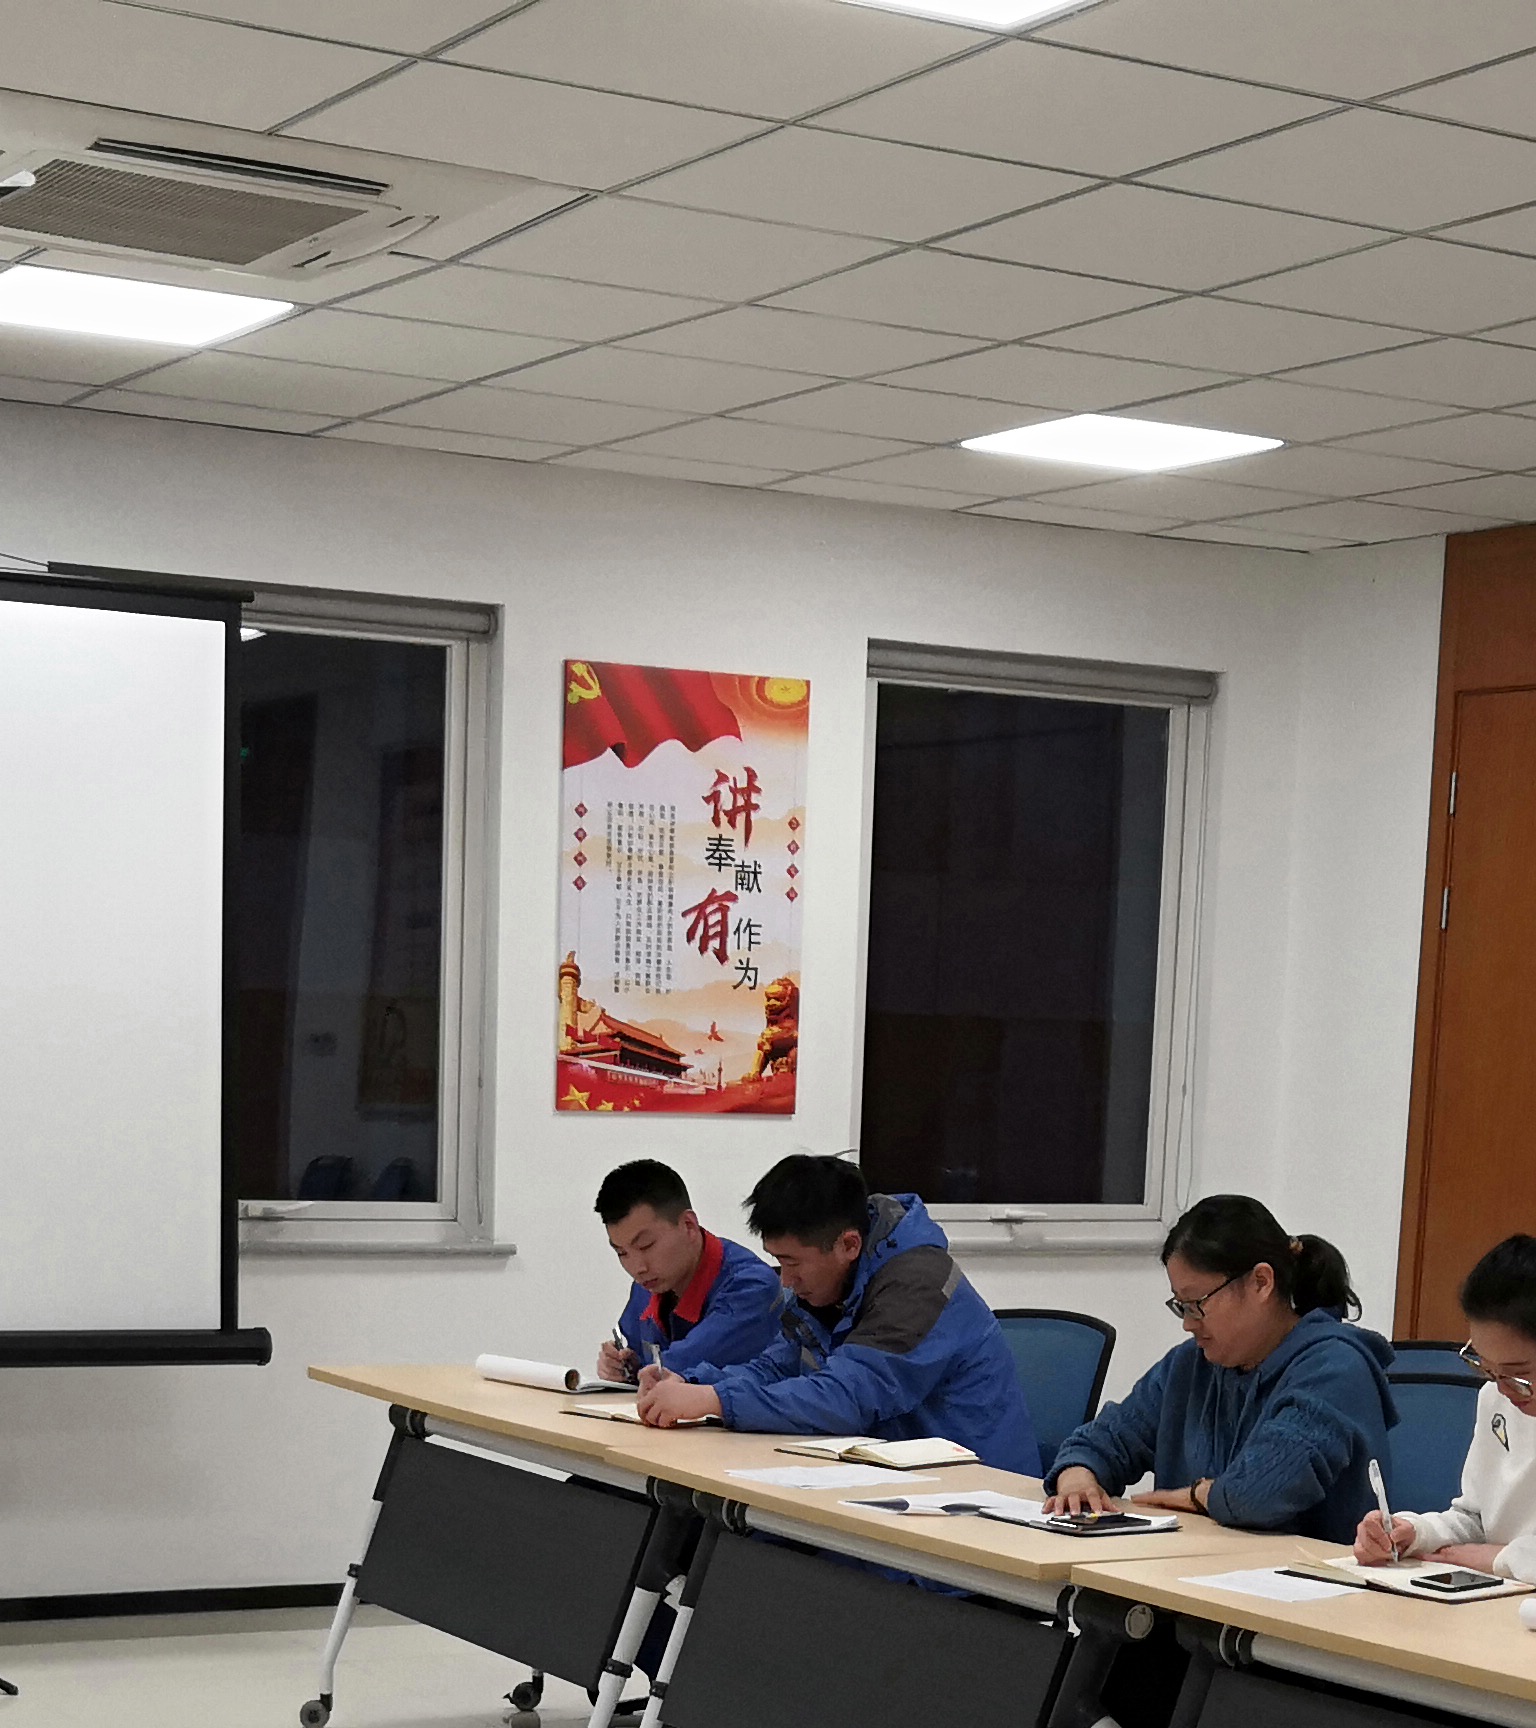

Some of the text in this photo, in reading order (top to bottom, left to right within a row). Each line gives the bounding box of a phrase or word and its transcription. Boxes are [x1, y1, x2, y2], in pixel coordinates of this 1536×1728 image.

[702, 766, 762, 848] 讲
[681, 887, 739, 966] 有
[733, 918, 762, 990] 作为
